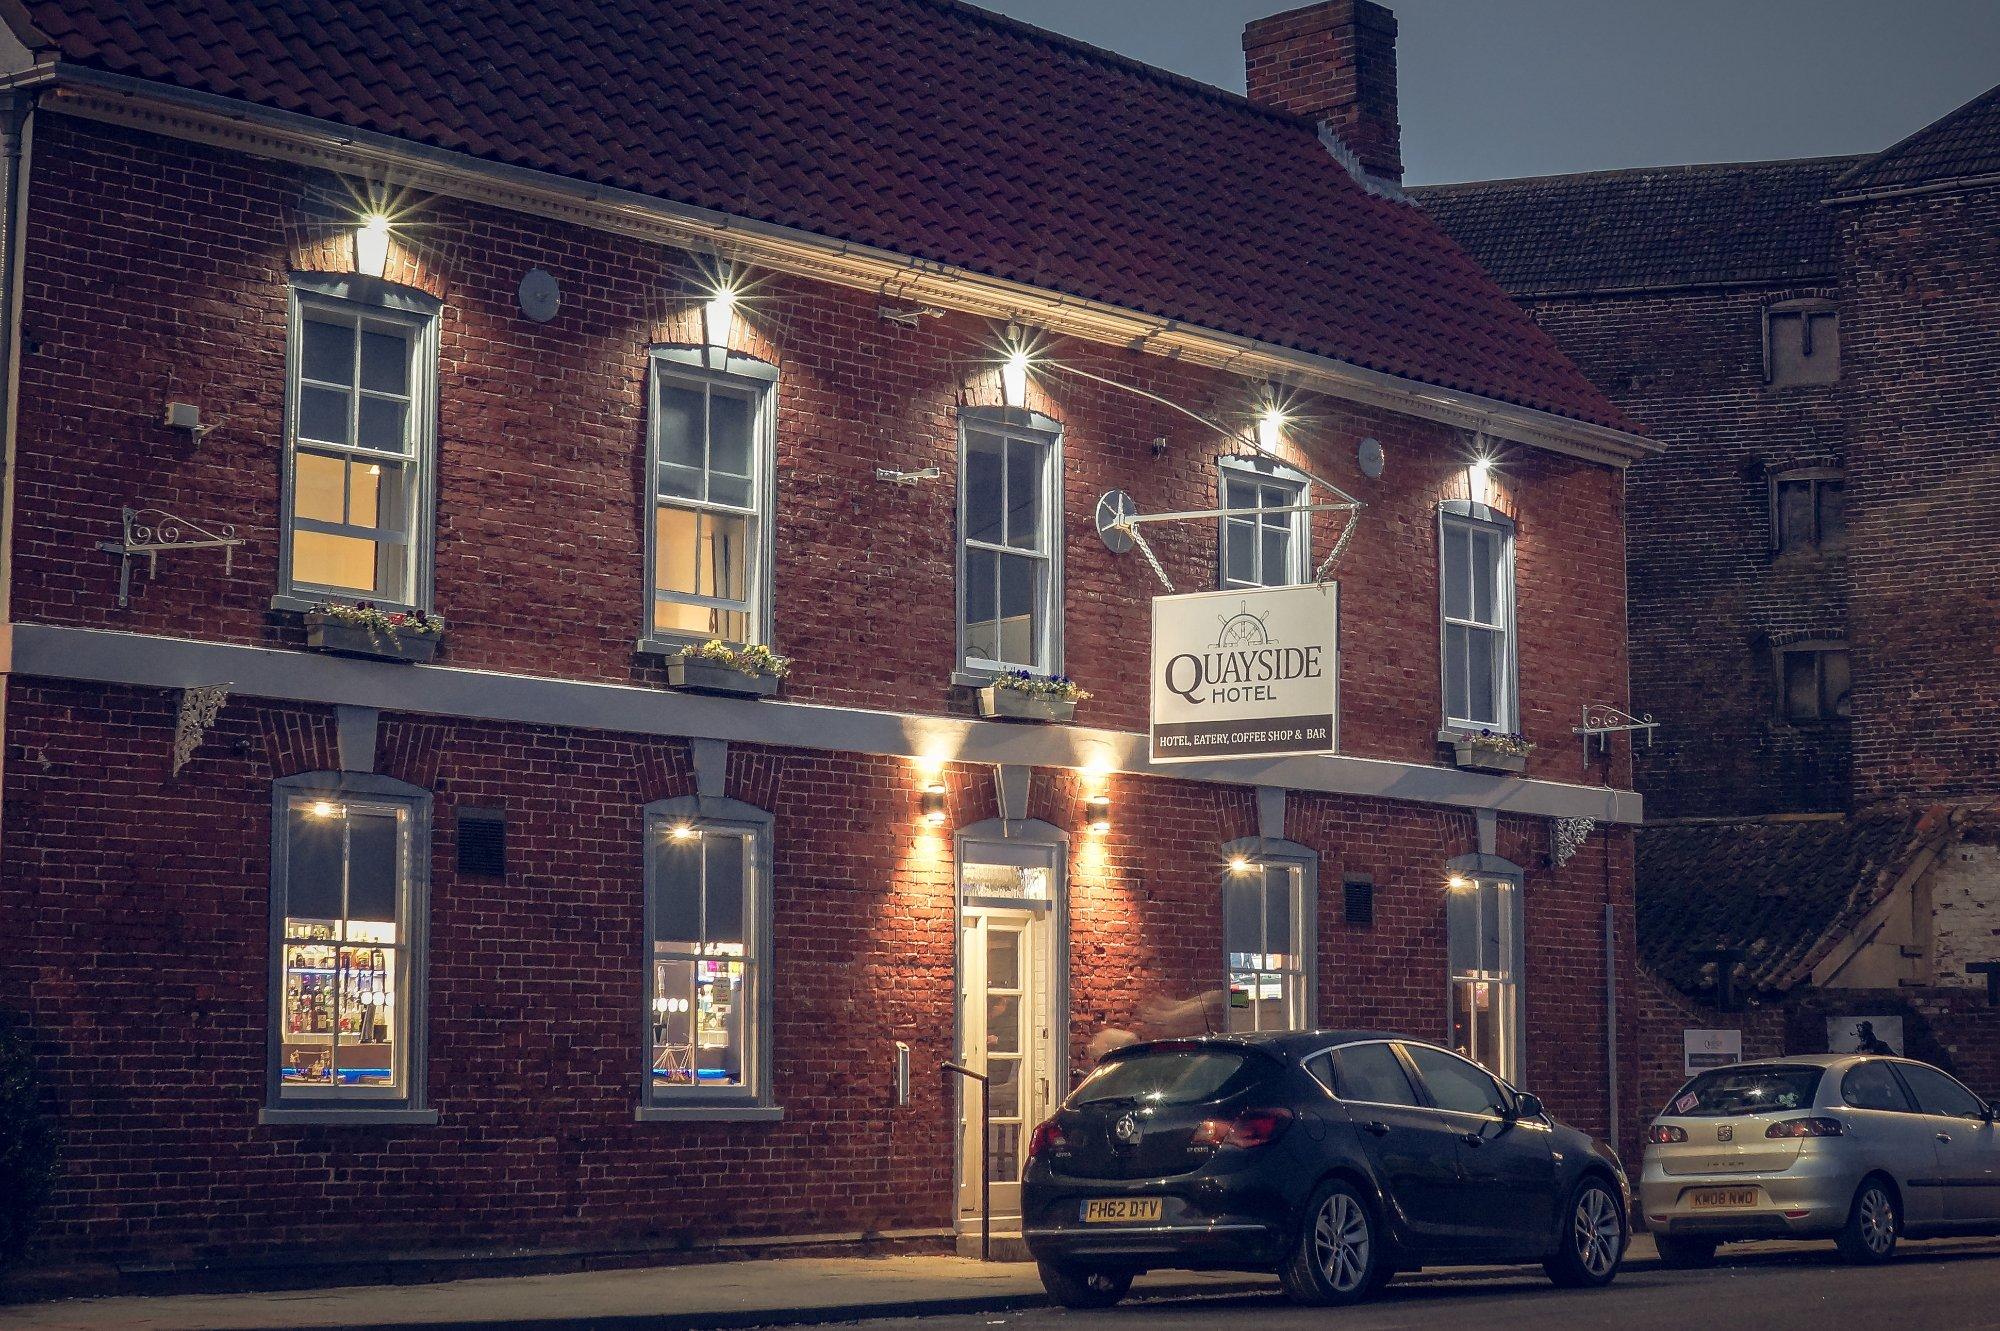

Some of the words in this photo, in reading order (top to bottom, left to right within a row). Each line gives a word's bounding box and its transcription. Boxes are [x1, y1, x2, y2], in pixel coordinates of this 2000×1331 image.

[1165, 646, 1322, 704] QUAYSIDE
[1212, 685, 1277, 704] HOTEL
[1160, 736, 1192, 747] HOTEL,
[1194, 734, 1230, 746] EATERY,
[1231, 731, 1266, 743] COFFEE
[1268, 730, 1293, 742] SHOP
[1295, 729, 1302, 740] &
[1306, 728, 1327, 739] BAR
[1088, 1201, 1126, 1218] FH62
[1129, 1200, 1158, 1217] DTV
